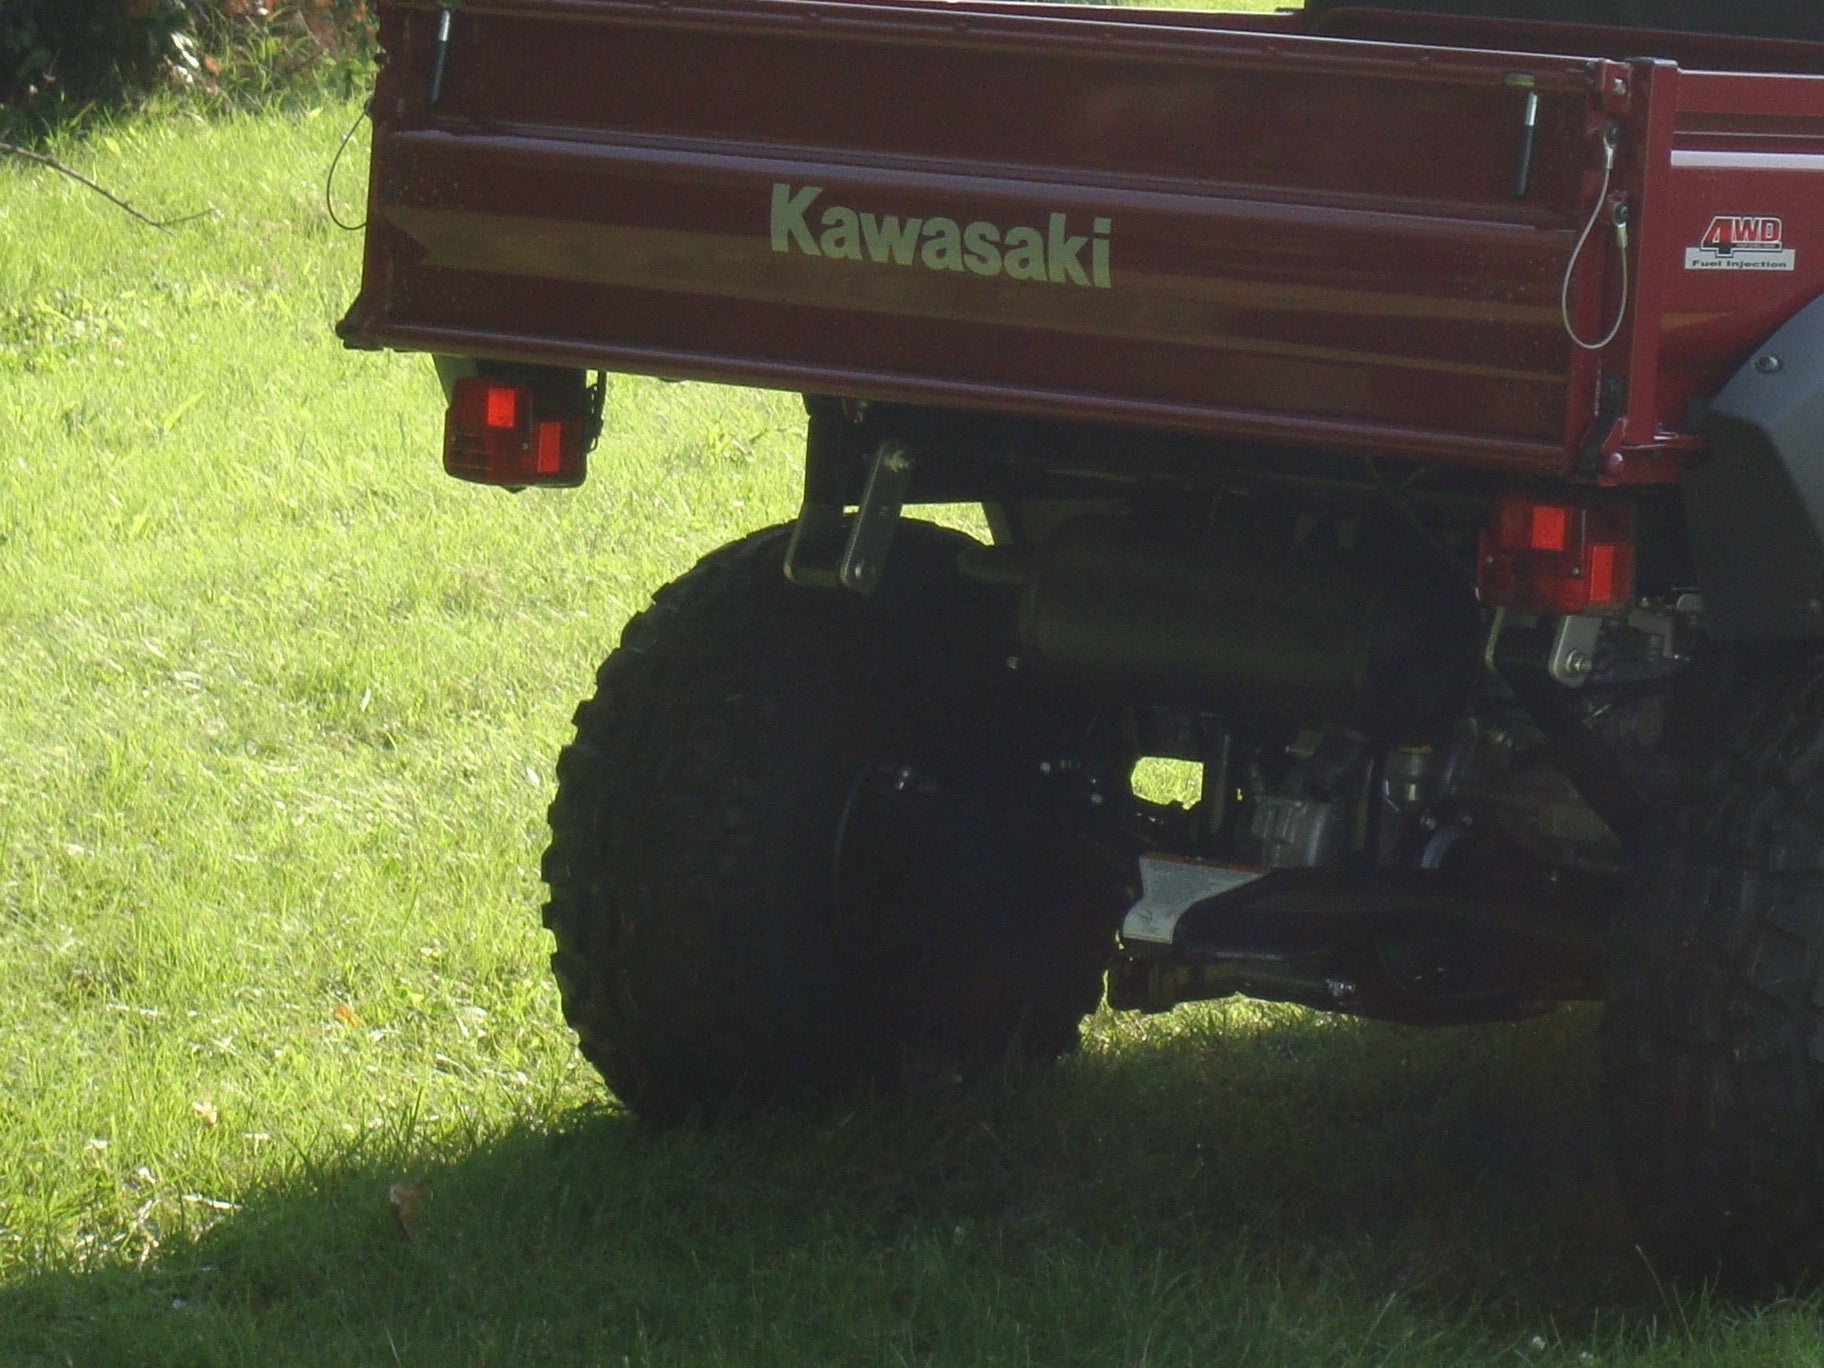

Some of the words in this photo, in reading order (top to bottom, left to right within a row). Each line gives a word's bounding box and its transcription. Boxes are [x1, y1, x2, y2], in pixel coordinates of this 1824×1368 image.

[770, 182, 1112, 289] Kawasaki
[1700, 215, 1782, 256] 4WD
[1692, 259, 1722, 267] Fuel
[1726, 260, 1787, 268] Injection
